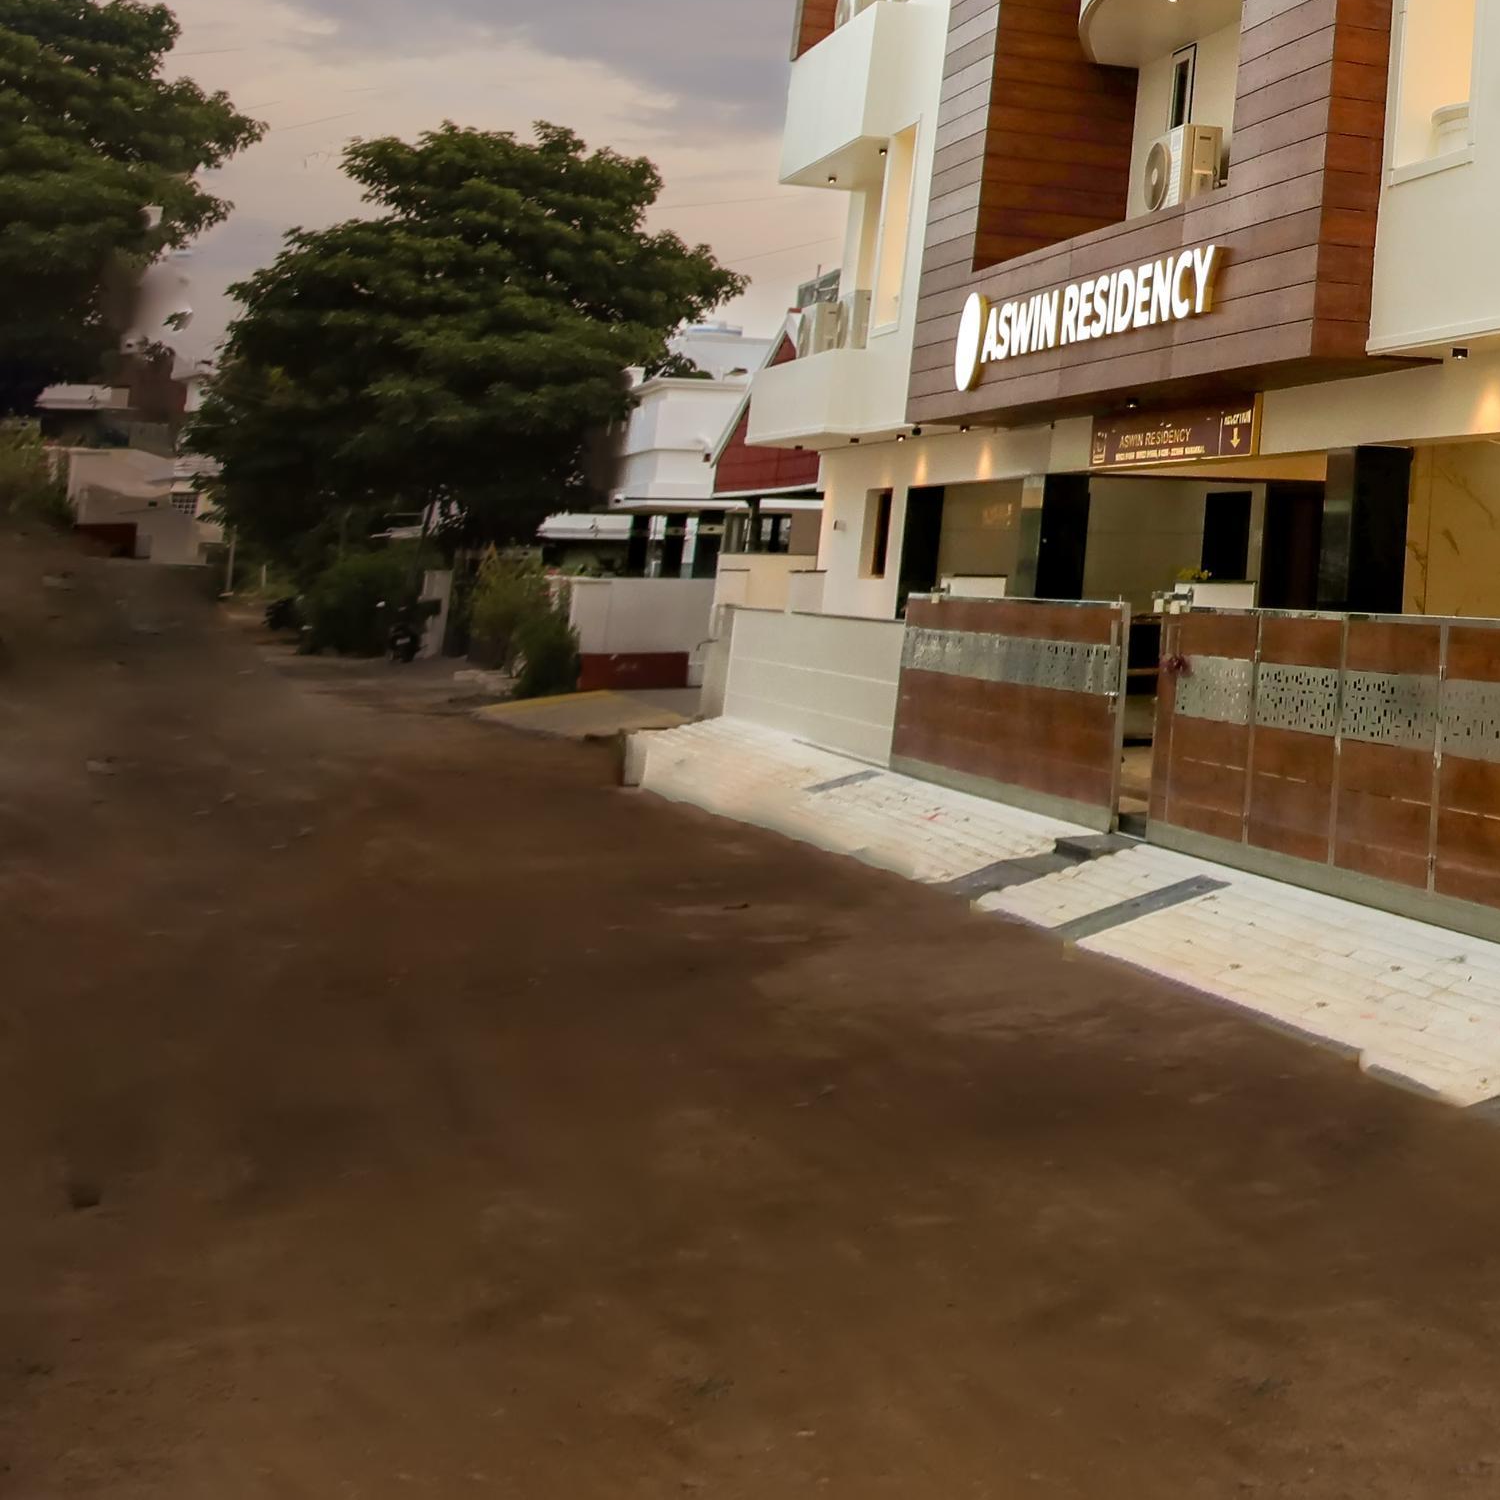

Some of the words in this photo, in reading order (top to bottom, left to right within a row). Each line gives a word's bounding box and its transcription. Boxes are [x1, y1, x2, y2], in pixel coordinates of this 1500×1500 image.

[980, 289, 1060, 364] ASWIN
[1060, 245, 1219, 345] RESIDENCY
[1119, 433, 1144, 449] ASWIN
[1144, 428, 1192, 446] RESIDENCY
